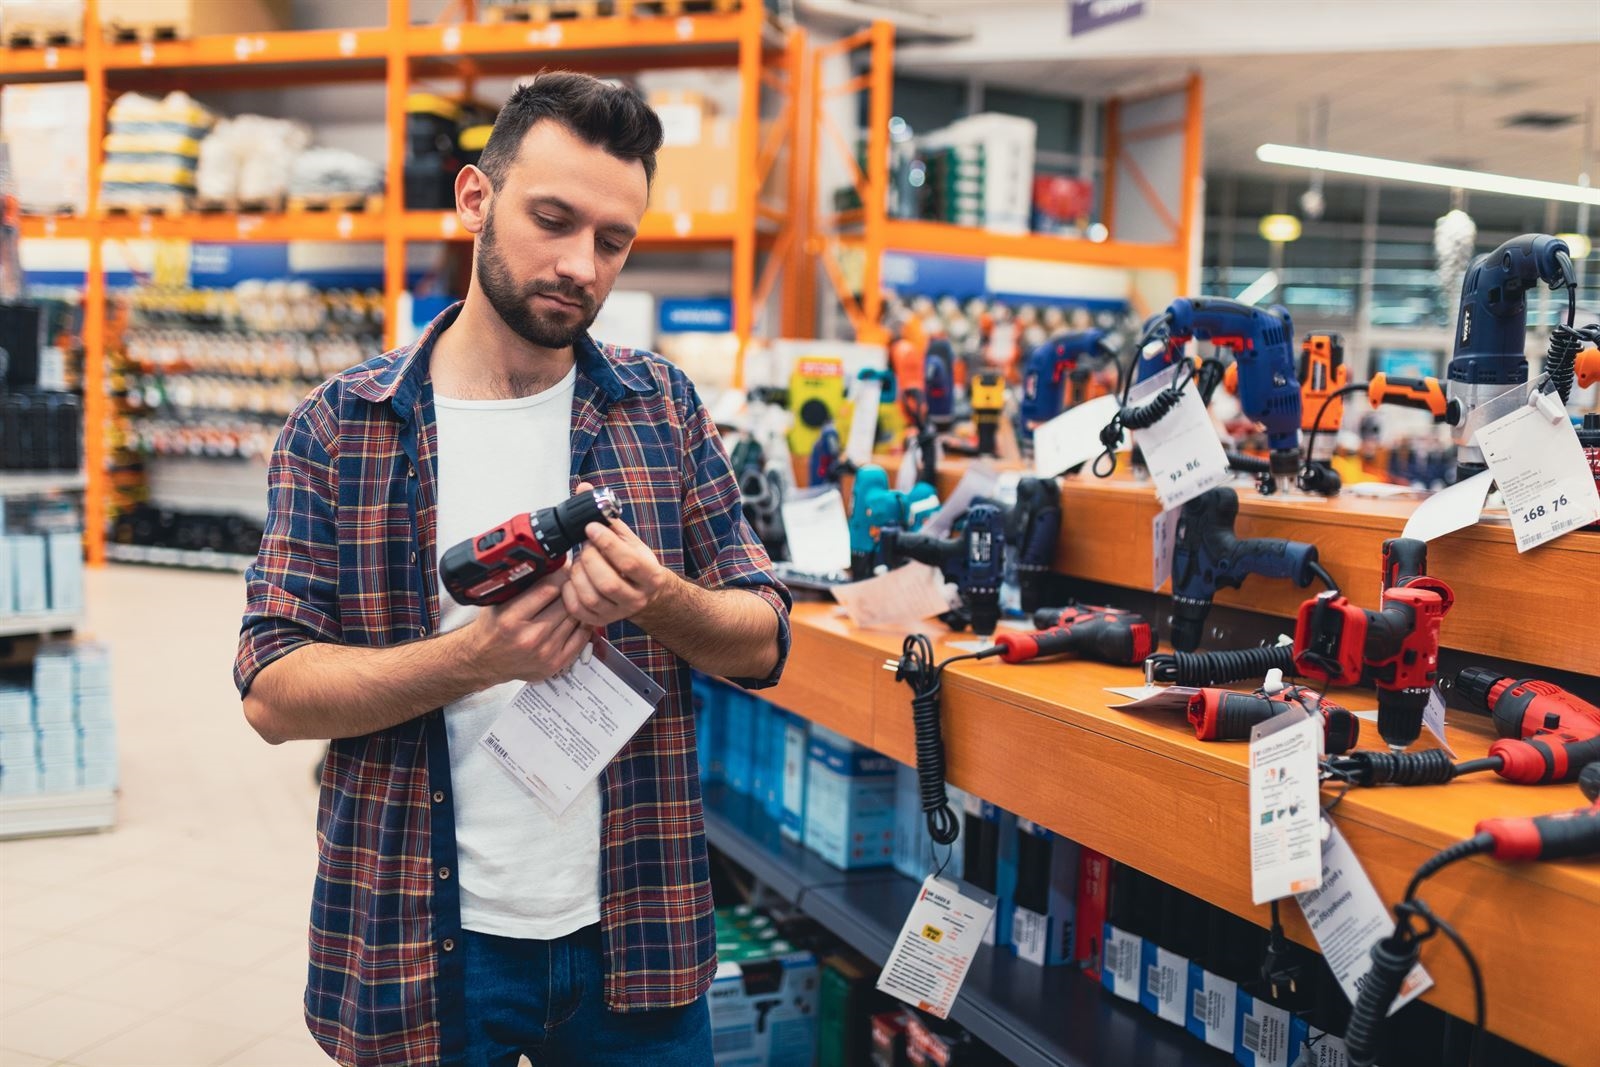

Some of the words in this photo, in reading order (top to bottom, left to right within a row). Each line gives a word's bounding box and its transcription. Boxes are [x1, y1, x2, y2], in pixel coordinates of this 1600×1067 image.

[1462, 310, 1470, 342] WATT
[1523, 505, 1546, 523] 168
[1552, 493, 1568, 513] 76
